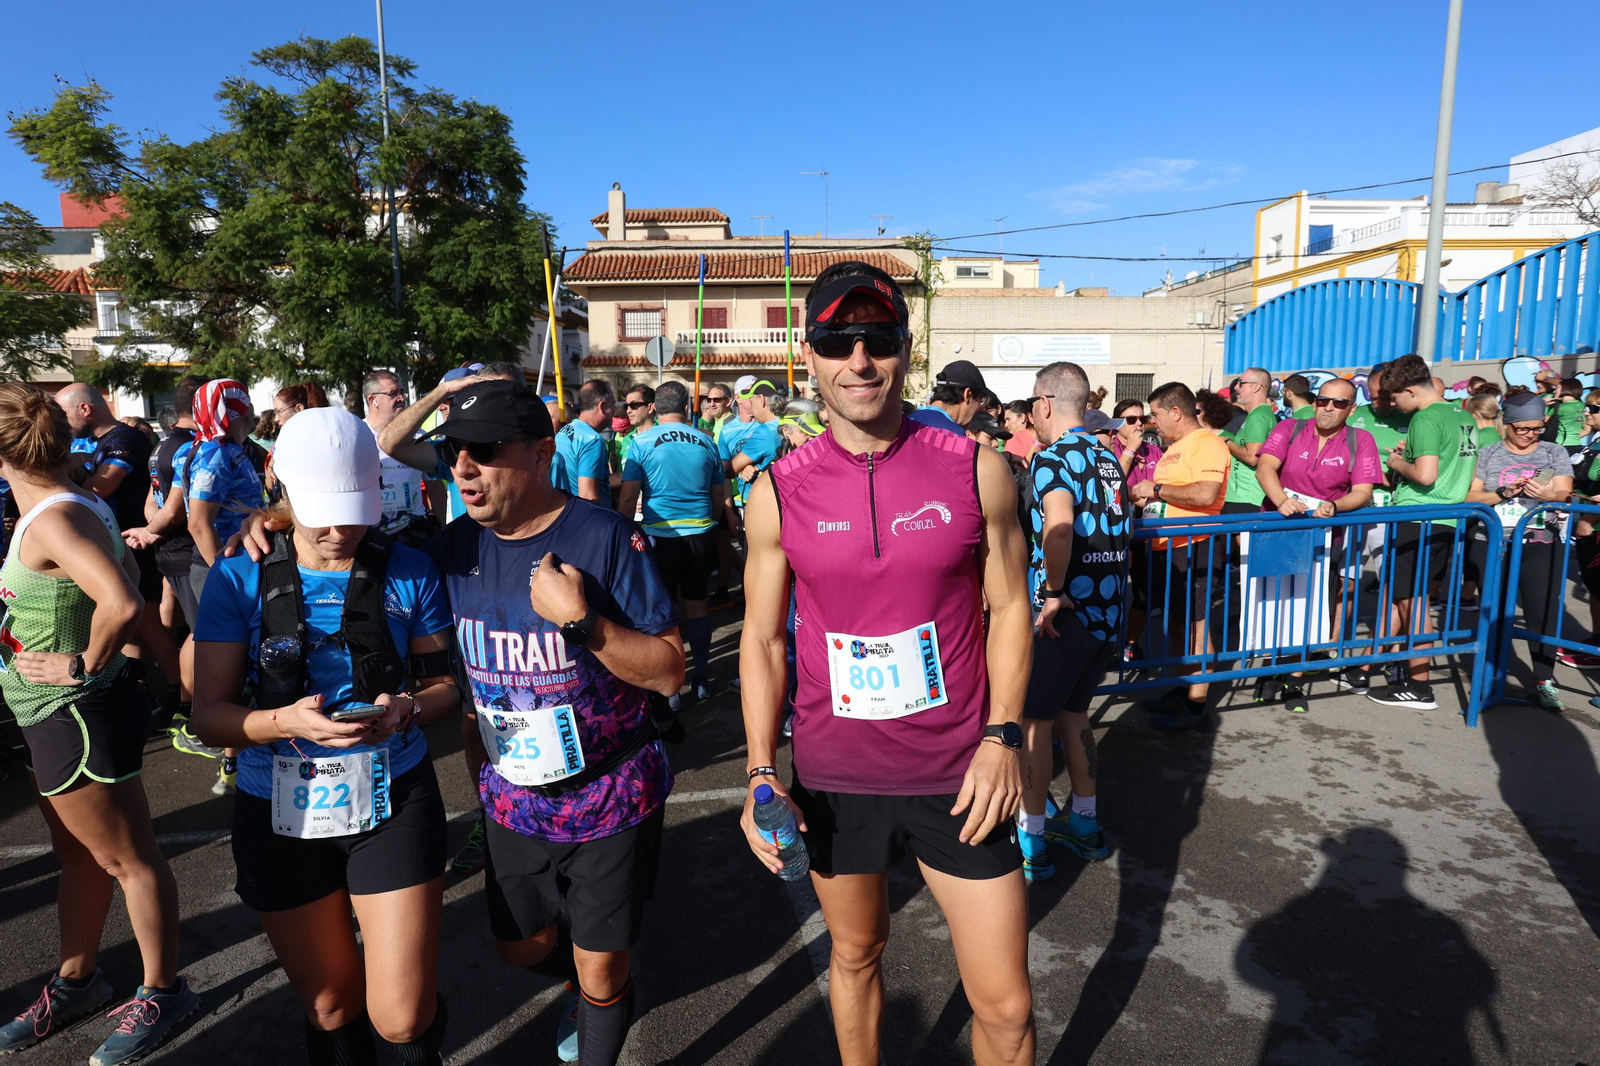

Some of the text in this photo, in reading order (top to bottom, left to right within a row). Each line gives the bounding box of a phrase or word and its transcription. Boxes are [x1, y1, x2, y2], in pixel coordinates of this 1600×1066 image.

[1502, 507, 1527, 517] 145
[489, 631, 577, 672] TRAIL
[866, 647, 894, 655] PIRATA
[470, 668, 500, 684] CASTILLO
[502, 675, 513, 686] DE
[515, 676, 531, 687] LAS
[532, 670, 578, 686] GUARDAS
[542, 685, 566, 694] OCTUBRE
[849, 664, 900, 691] 801
[495, 735, 540, 759] 825
[558, 710, 580, 770] PIRATILLA
[293, 783, 351, 810] 822
[374, 755, 387, 823] PIRATILLA
